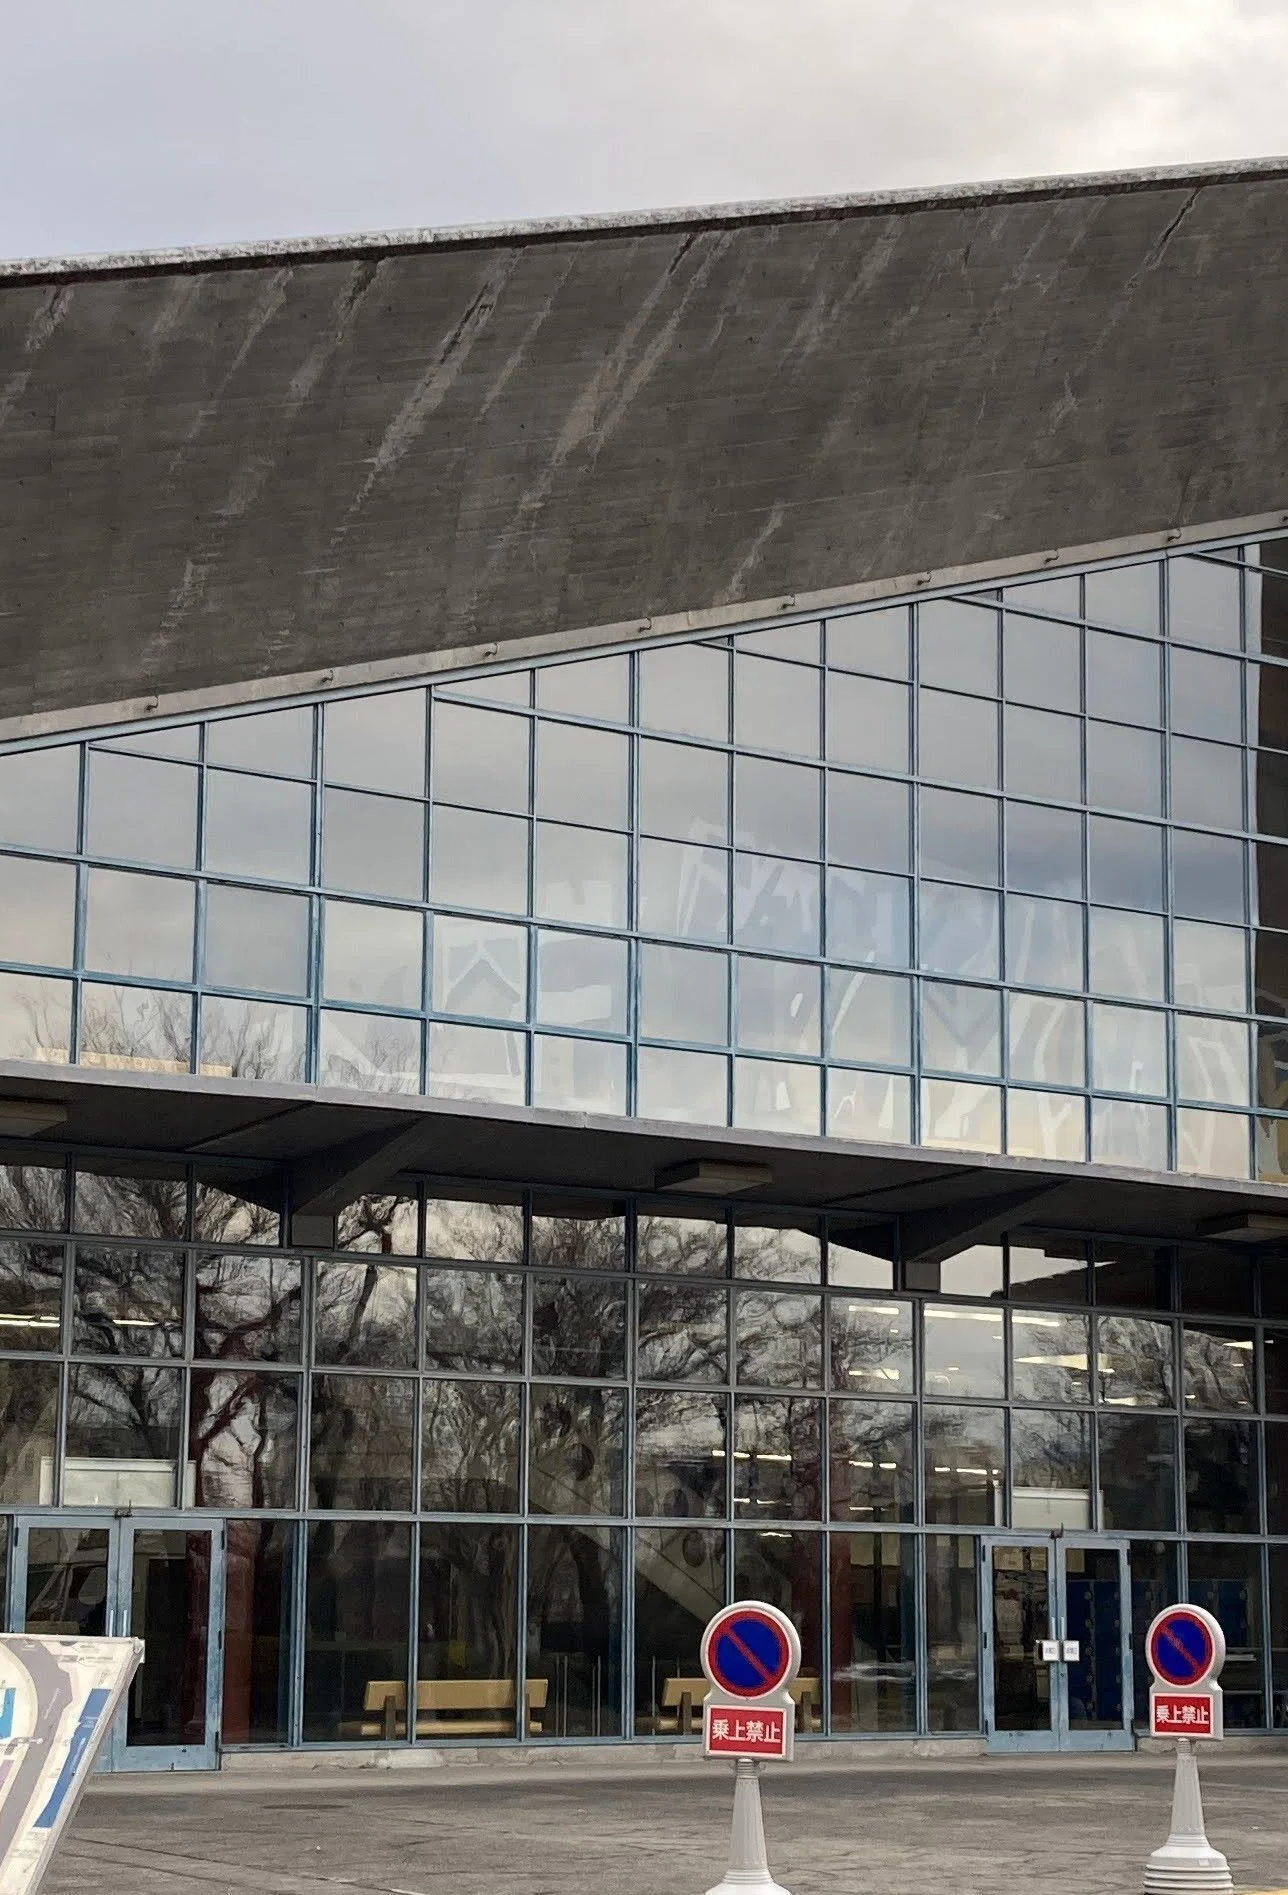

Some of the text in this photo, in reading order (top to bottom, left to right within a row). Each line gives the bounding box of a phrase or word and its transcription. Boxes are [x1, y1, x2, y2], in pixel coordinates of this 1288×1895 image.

[1156, 1704, 1209, 1725] 乗上禁止
[712, 1718, 781, 1743] 乗上禁止
